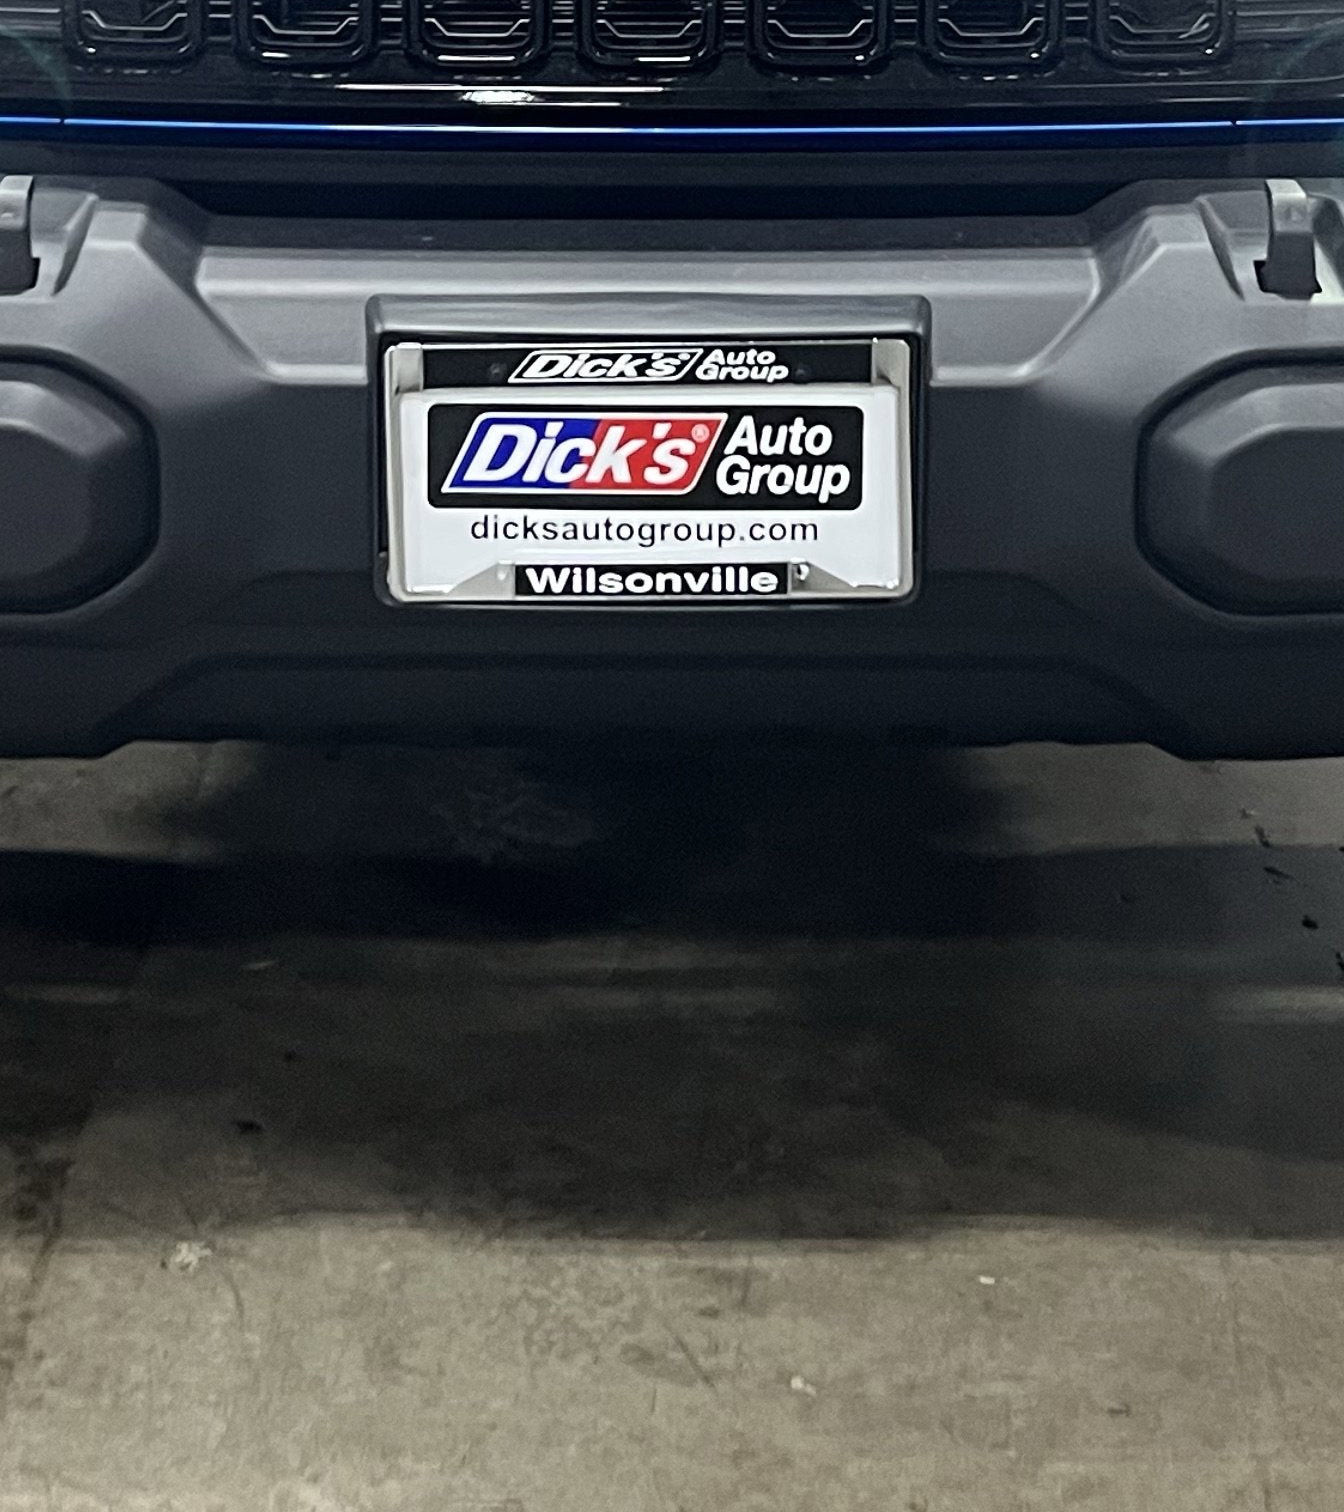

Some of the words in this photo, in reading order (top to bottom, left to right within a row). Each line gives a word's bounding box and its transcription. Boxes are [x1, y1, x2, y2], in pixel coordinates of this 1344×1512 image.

[522, 352, 682, 378] Dick's
[702, 348, 776, 365] Auto
[695, 364, 789, 382] Group
[724, 415, 833, 457] Auto
[463, 420, 697, 485] Dick's
[716, 456, 850, 504] Group
[471, 515, 818, 547] dicksautogroup.com
[524, 566, 778, 594] Wilsonville
